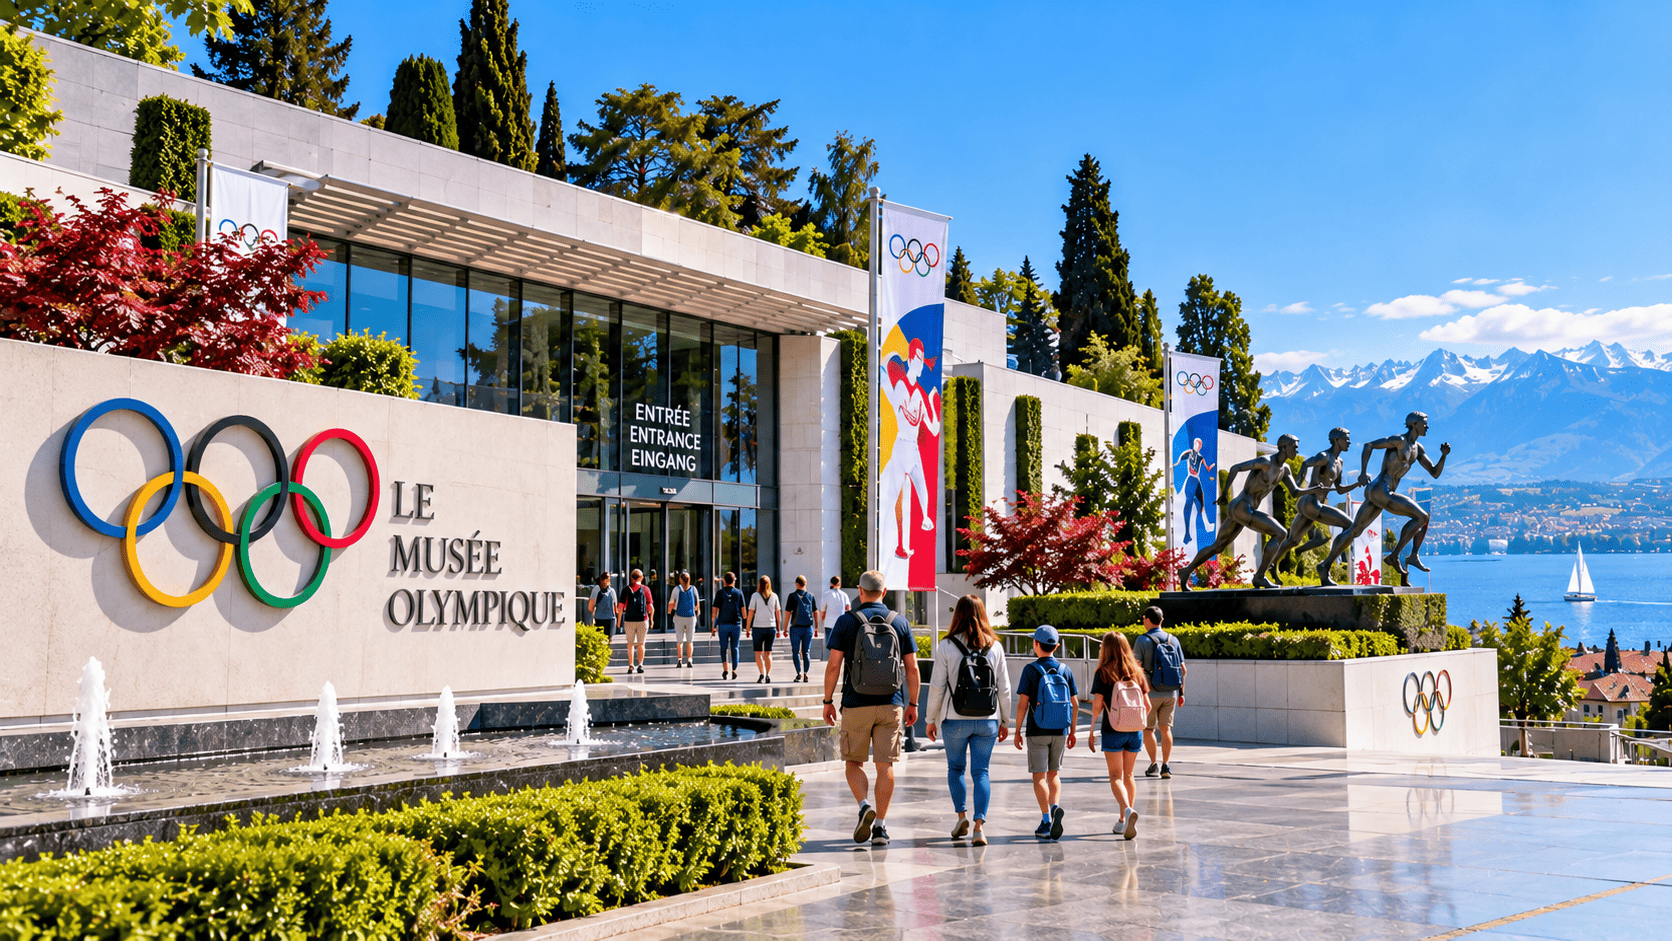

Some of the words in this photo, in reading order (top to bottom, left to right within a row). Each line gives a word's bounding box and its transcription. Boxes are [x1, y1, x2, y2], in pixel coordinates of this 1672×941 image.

[635, 403, 691, 427] ENTRÉE
[630, 425, 701, 450] ENTRANCE
[631, 449, 696, 472] EINGANG
[393, 480, 435, 520] LE
[391, 530, 502, 575] MUSÉE
[387, 588, 566, 632] OLYMPIQUE
